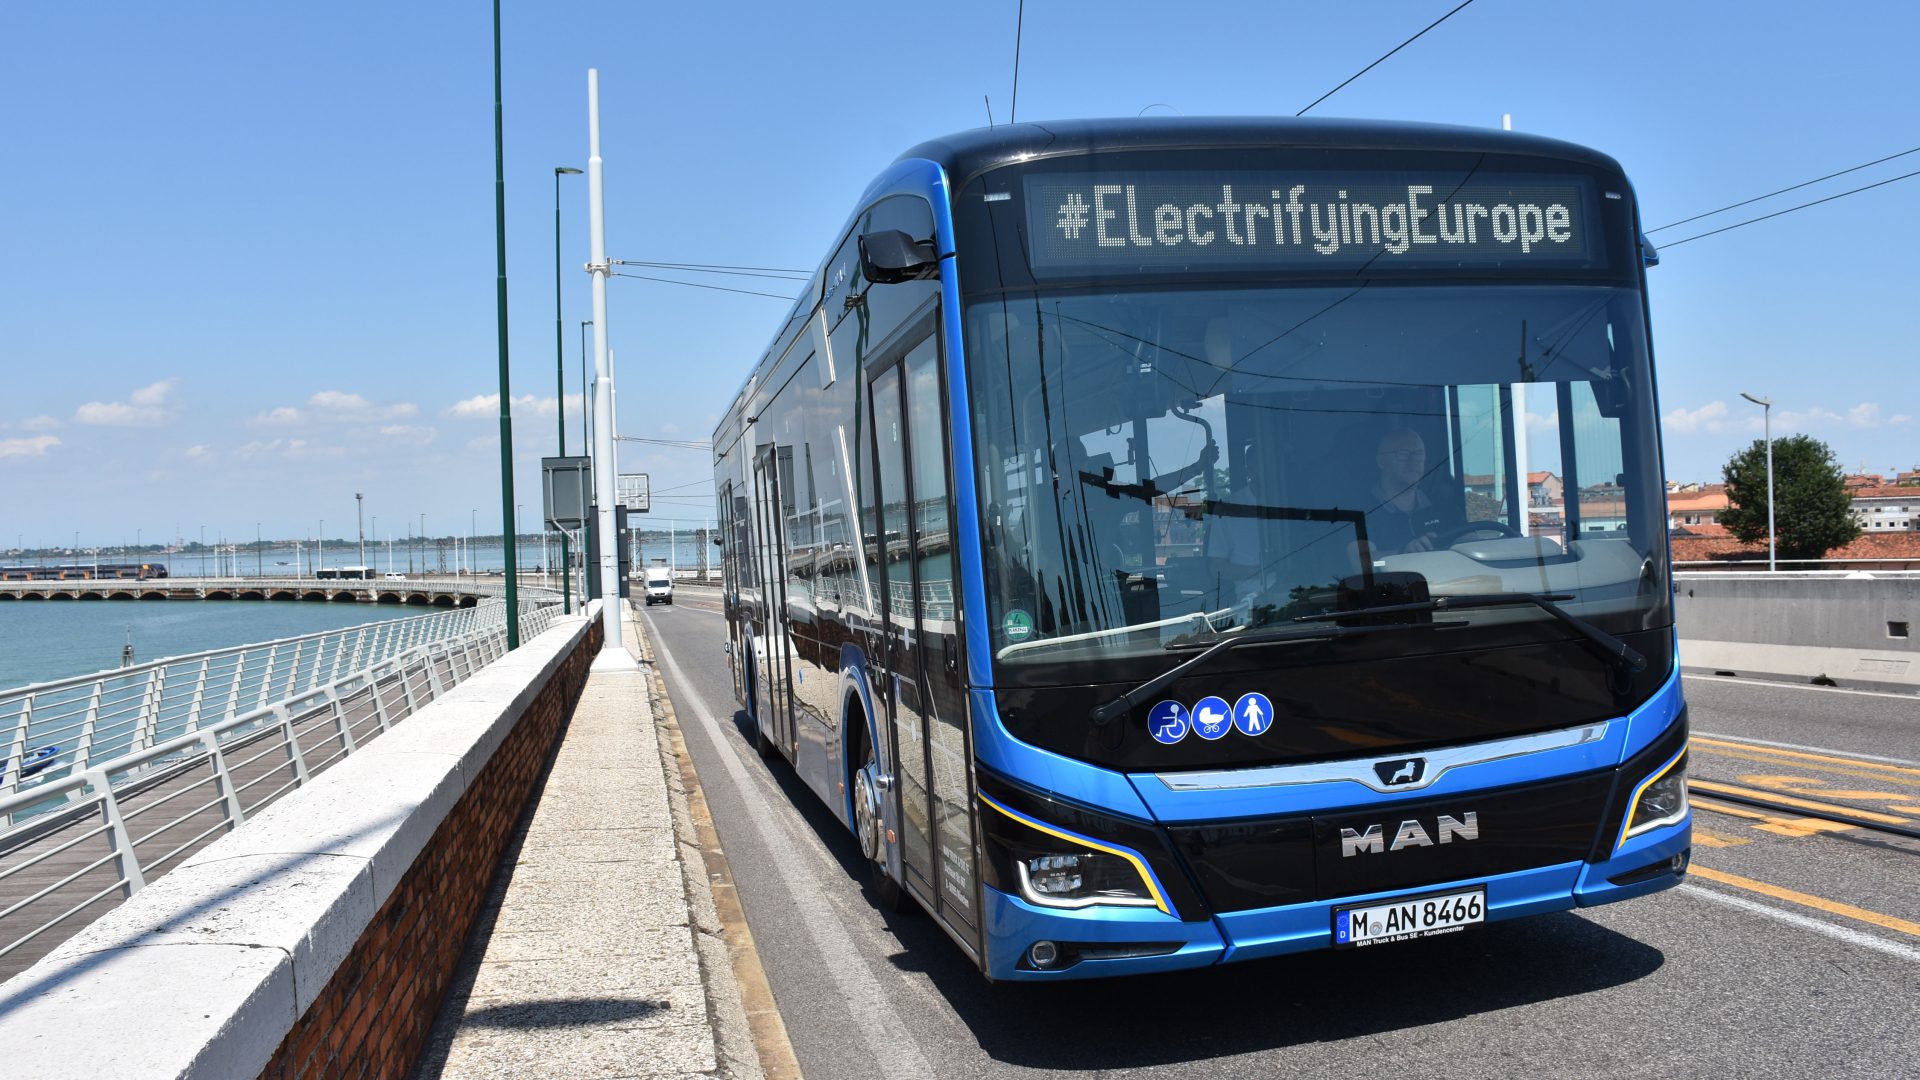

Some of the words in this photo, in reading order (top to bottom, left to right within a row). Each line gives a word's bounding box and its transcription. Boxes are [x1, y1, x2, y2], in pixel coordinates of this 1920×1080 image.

[1340, 811, 1479, 858] MAN
[1352, 911, 1368, 938] M
[1385, 904, 1417, 933] AN
[1423, 895, 1481, 927] 8466
[1340, 930, 1346, 939] D
[1424, 925, 1465, 937] Kundencenter
